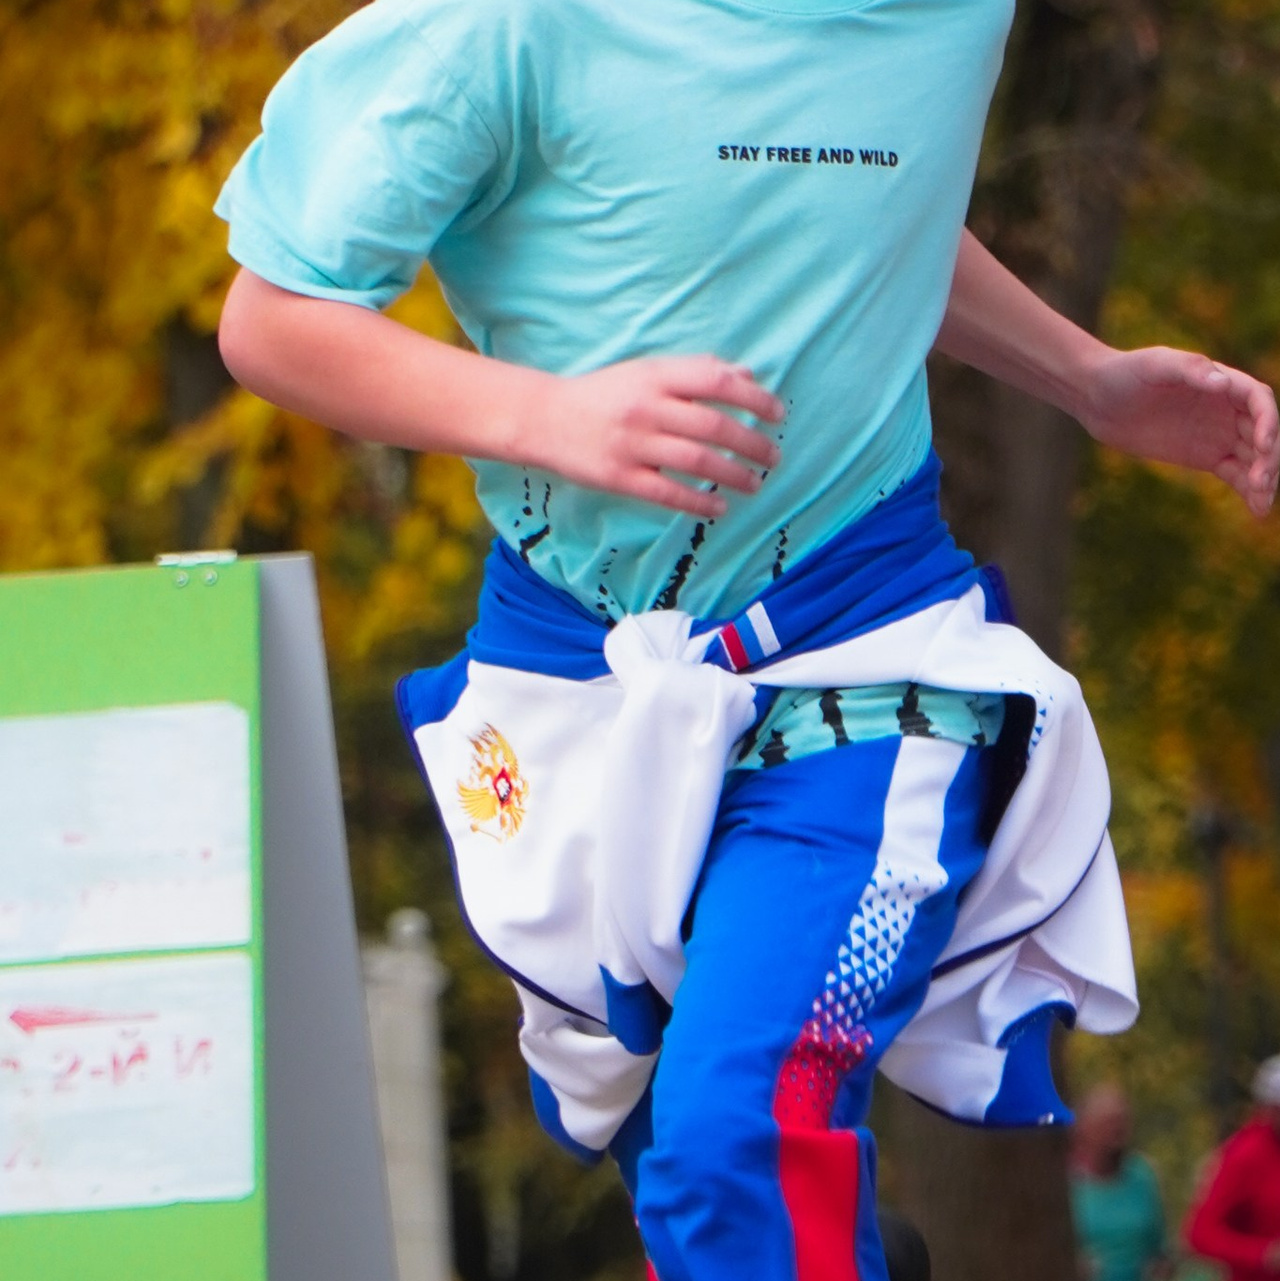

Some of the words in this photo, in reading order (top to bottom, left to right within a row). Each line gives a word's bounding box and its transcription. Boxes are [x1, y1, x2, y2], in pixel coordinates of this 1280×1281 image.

[717, 144, 761, 162] STAY
[766, 146, 812, 164] FREE
[816, 147, 855, 165] AND
[858, 148, 899, 168] WILD
